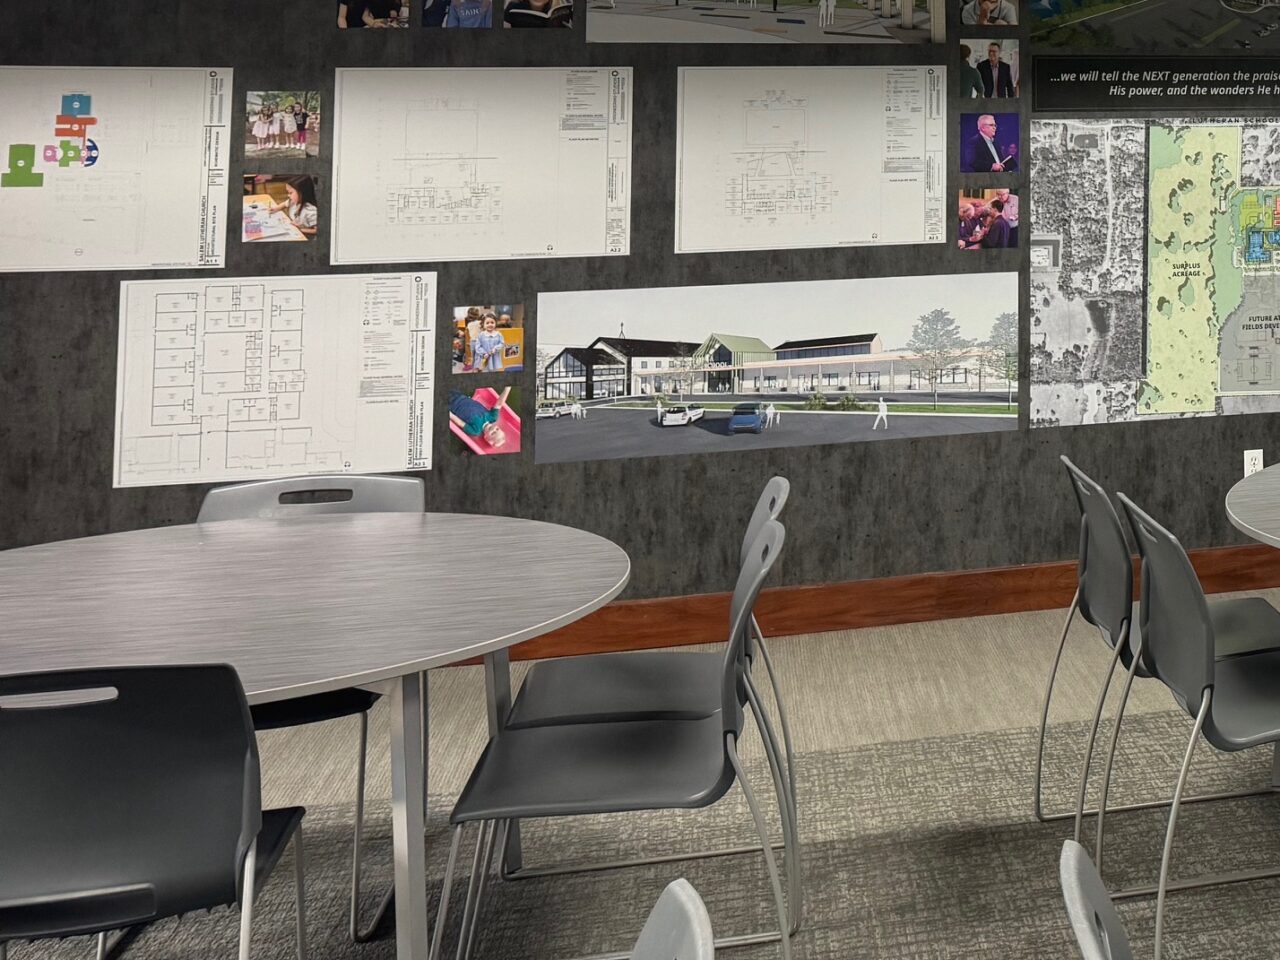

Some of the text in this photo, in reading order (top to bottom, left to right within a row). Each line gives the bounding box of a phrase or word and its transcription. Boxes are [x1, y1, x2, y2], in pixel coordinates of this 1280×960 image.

[1079, 70, 1098, 82] will
[1101, 70, 1120, 82] tell
[1121, 70, 1140, 82] the
[1142, 71, 1171, 81] NEXT
[1172, 71, 1230, 84] generation
[1232, 70, 1250, 81] the
[1109, 85, 1126, 96] His
[1128, 86, 1164, 98] power,
[1166, 85, 1188, 96] and
[1190, 85, 1208, 96] the
[1210, 84, 1255, 96] wonders
[1257, 85, 1271, 95] He
